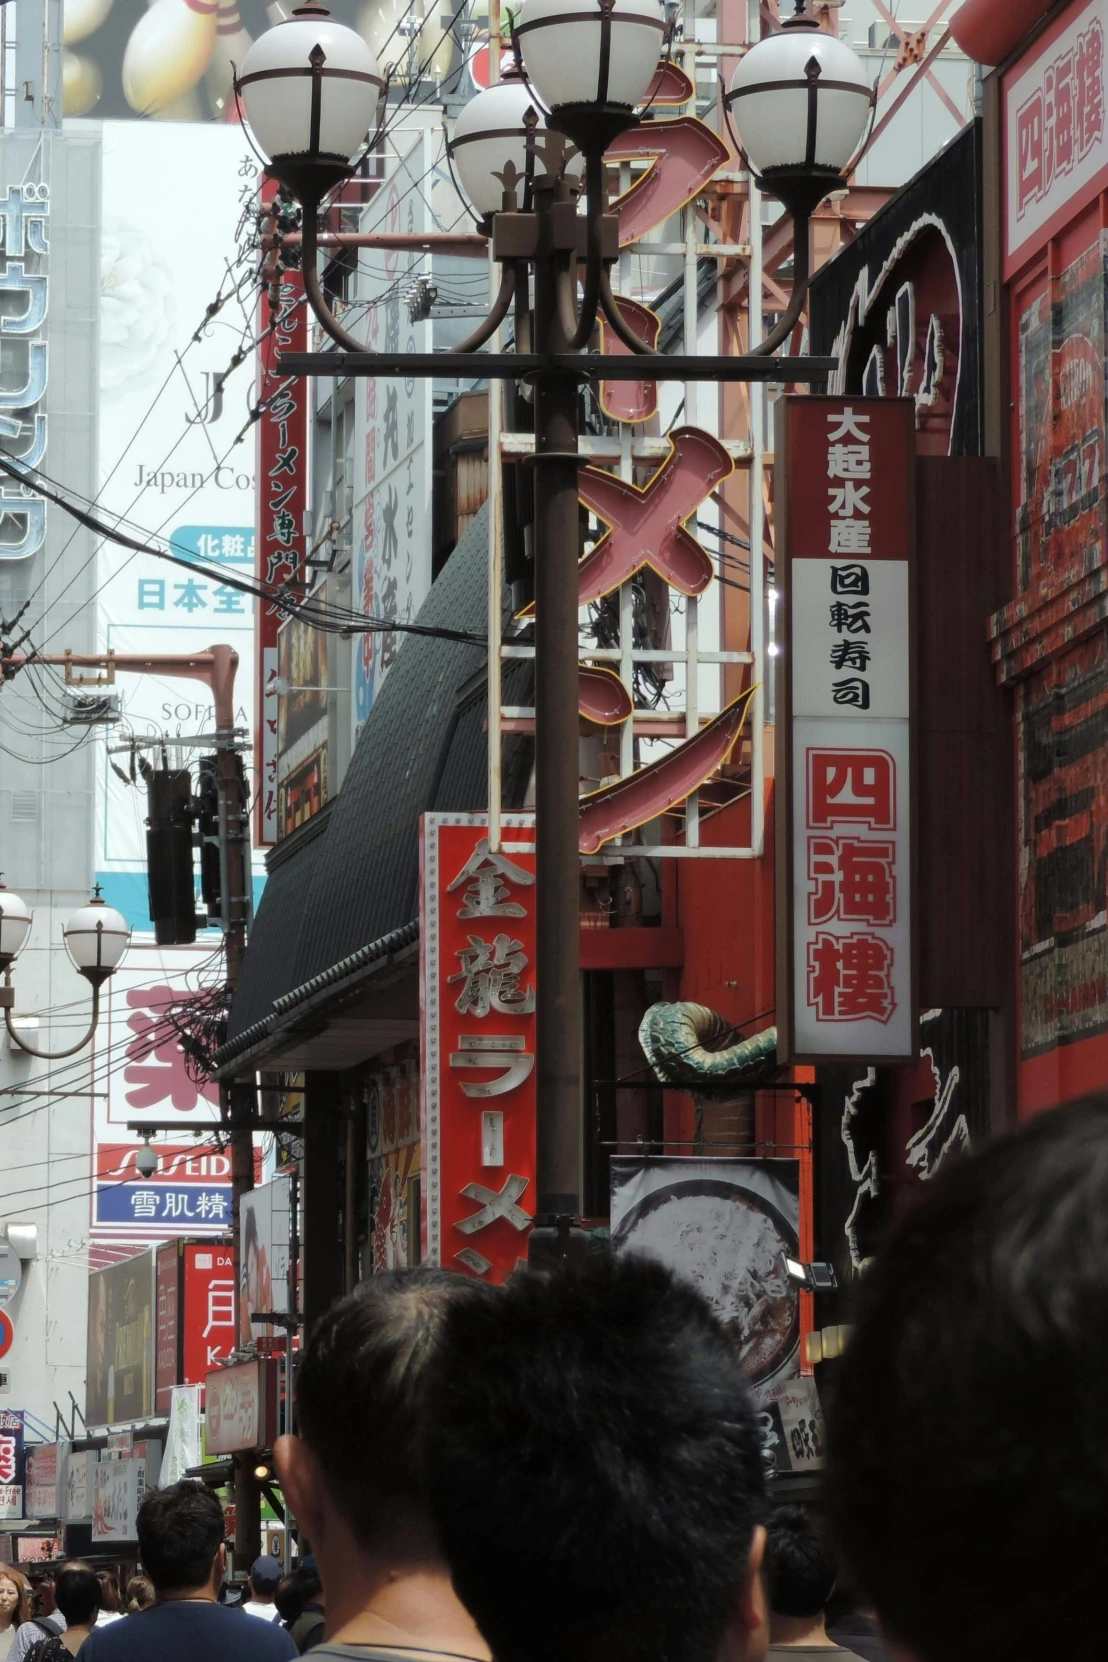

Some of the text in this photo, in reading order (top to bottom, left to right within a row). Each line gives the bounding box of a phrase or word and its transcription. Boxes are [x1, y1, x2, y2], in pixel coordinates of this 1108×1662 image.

[134, 464, 205, 495] Japan
[827, 407, 873, 554] 大起水産
[137, 578, 255, 615] 日本全
[828, 564, 872, 710] 回転寿司
[806, 747, 898, 1025] 四海樓
[130, 1190, 229, 1219] 雪肌精
